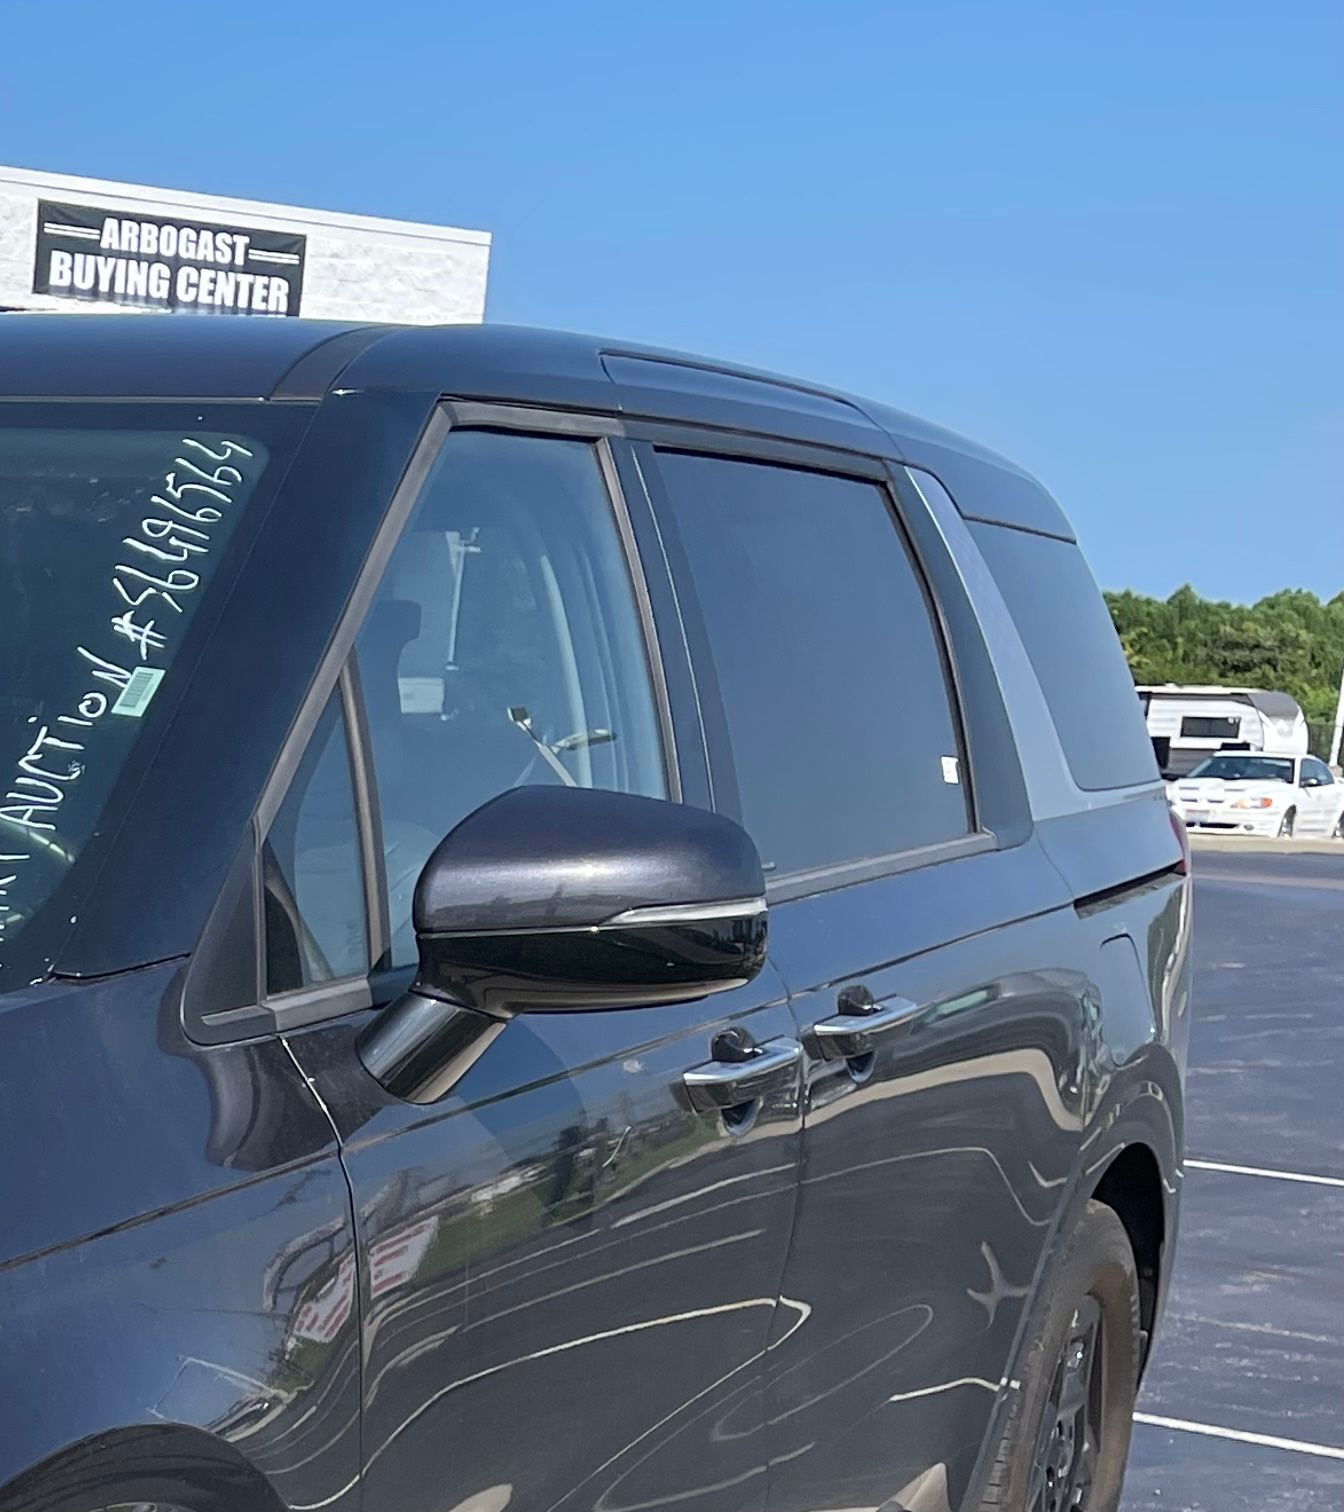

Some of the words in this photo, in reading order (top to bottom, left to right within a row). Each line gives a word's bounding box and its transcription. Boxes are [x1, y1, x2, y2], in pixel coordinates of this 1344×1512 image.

[100, 217, 250, 266] ARBOGAST
[49, 249, 171, 300] BUYING
[175, 266, 290, 313] CENTER
